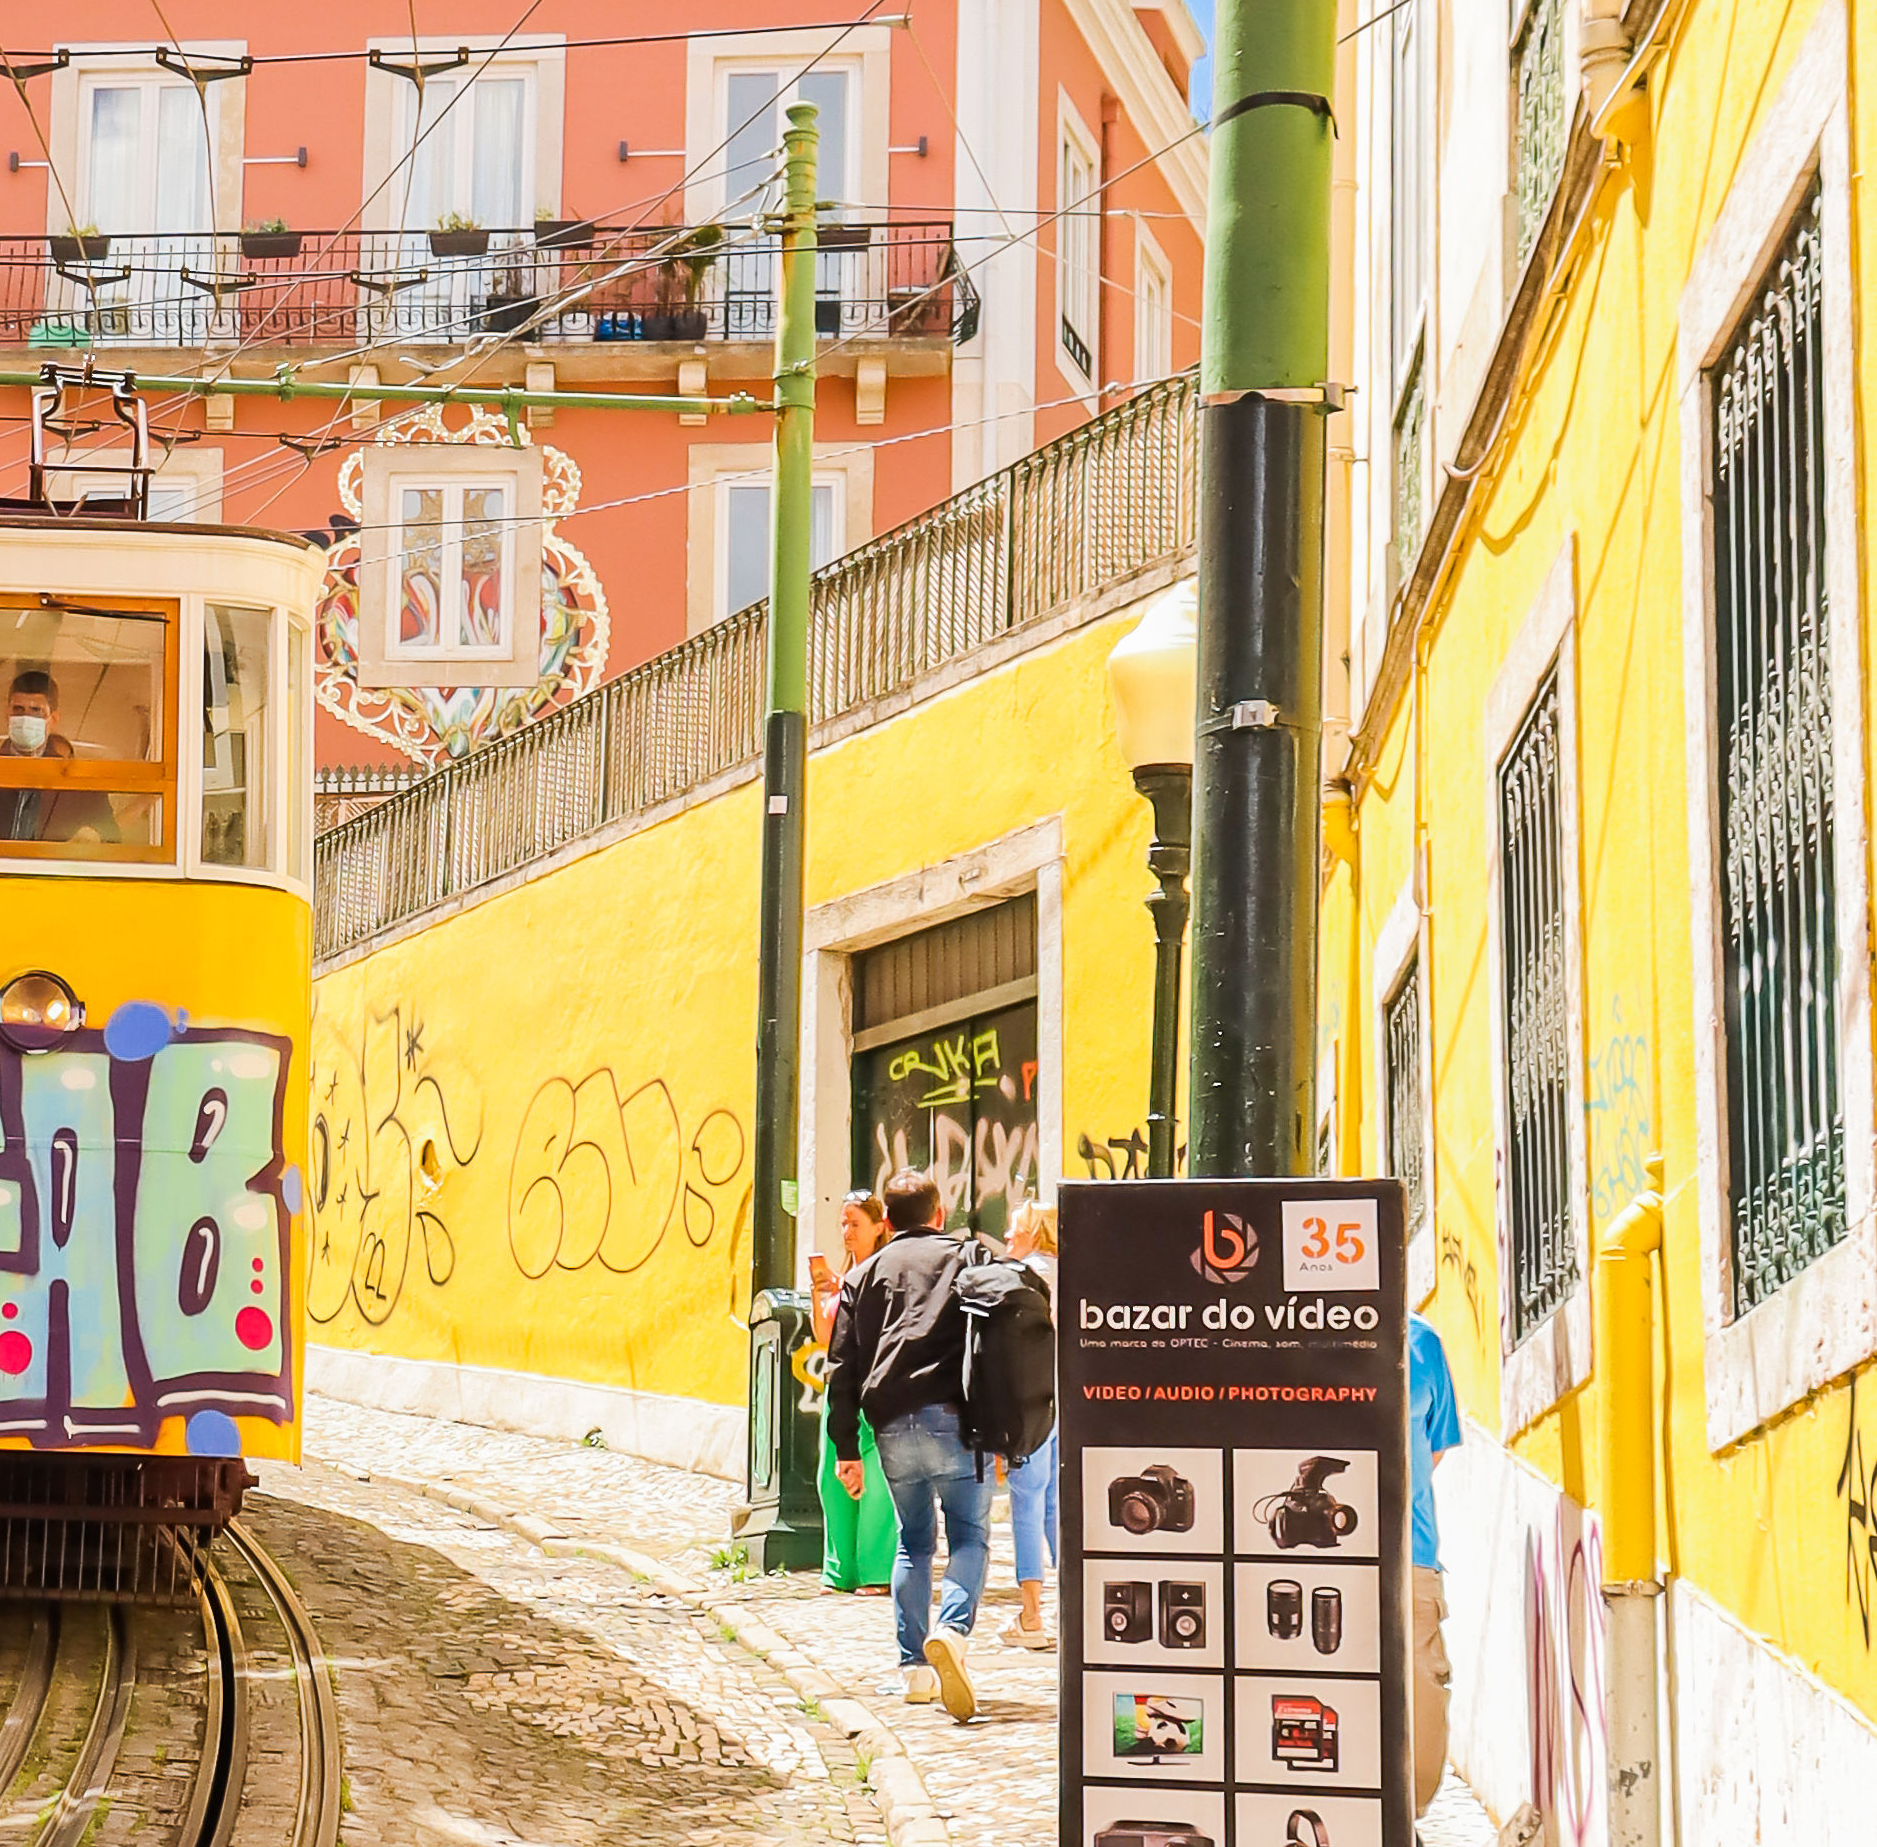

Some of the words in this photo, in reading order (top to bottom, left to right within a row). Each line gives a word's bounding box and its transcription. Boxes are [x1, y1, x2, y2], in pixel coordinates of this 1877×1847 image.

[1300, 1217, 1365, 1265] 35
[1299, 1261, 1334, 1272] Anos
[1079, 1298, 1192, 1331] bazar
[1202, 1298, 1255, 1331] do
[1264, 1295, 1379, 1331] vídeo
[1079, 1337, 1106, 1348] Uma
[1110, 1340, 1148, 1348] marca
[1170, 1338, 1208, 1349] OPTEC
[1083, 1385, 1141, 1400] VIDEO
[1153, 1385, 1215, 1401] AUDIO
[1228, 1386, 1377, 1402] PHOTOGRAPHY
